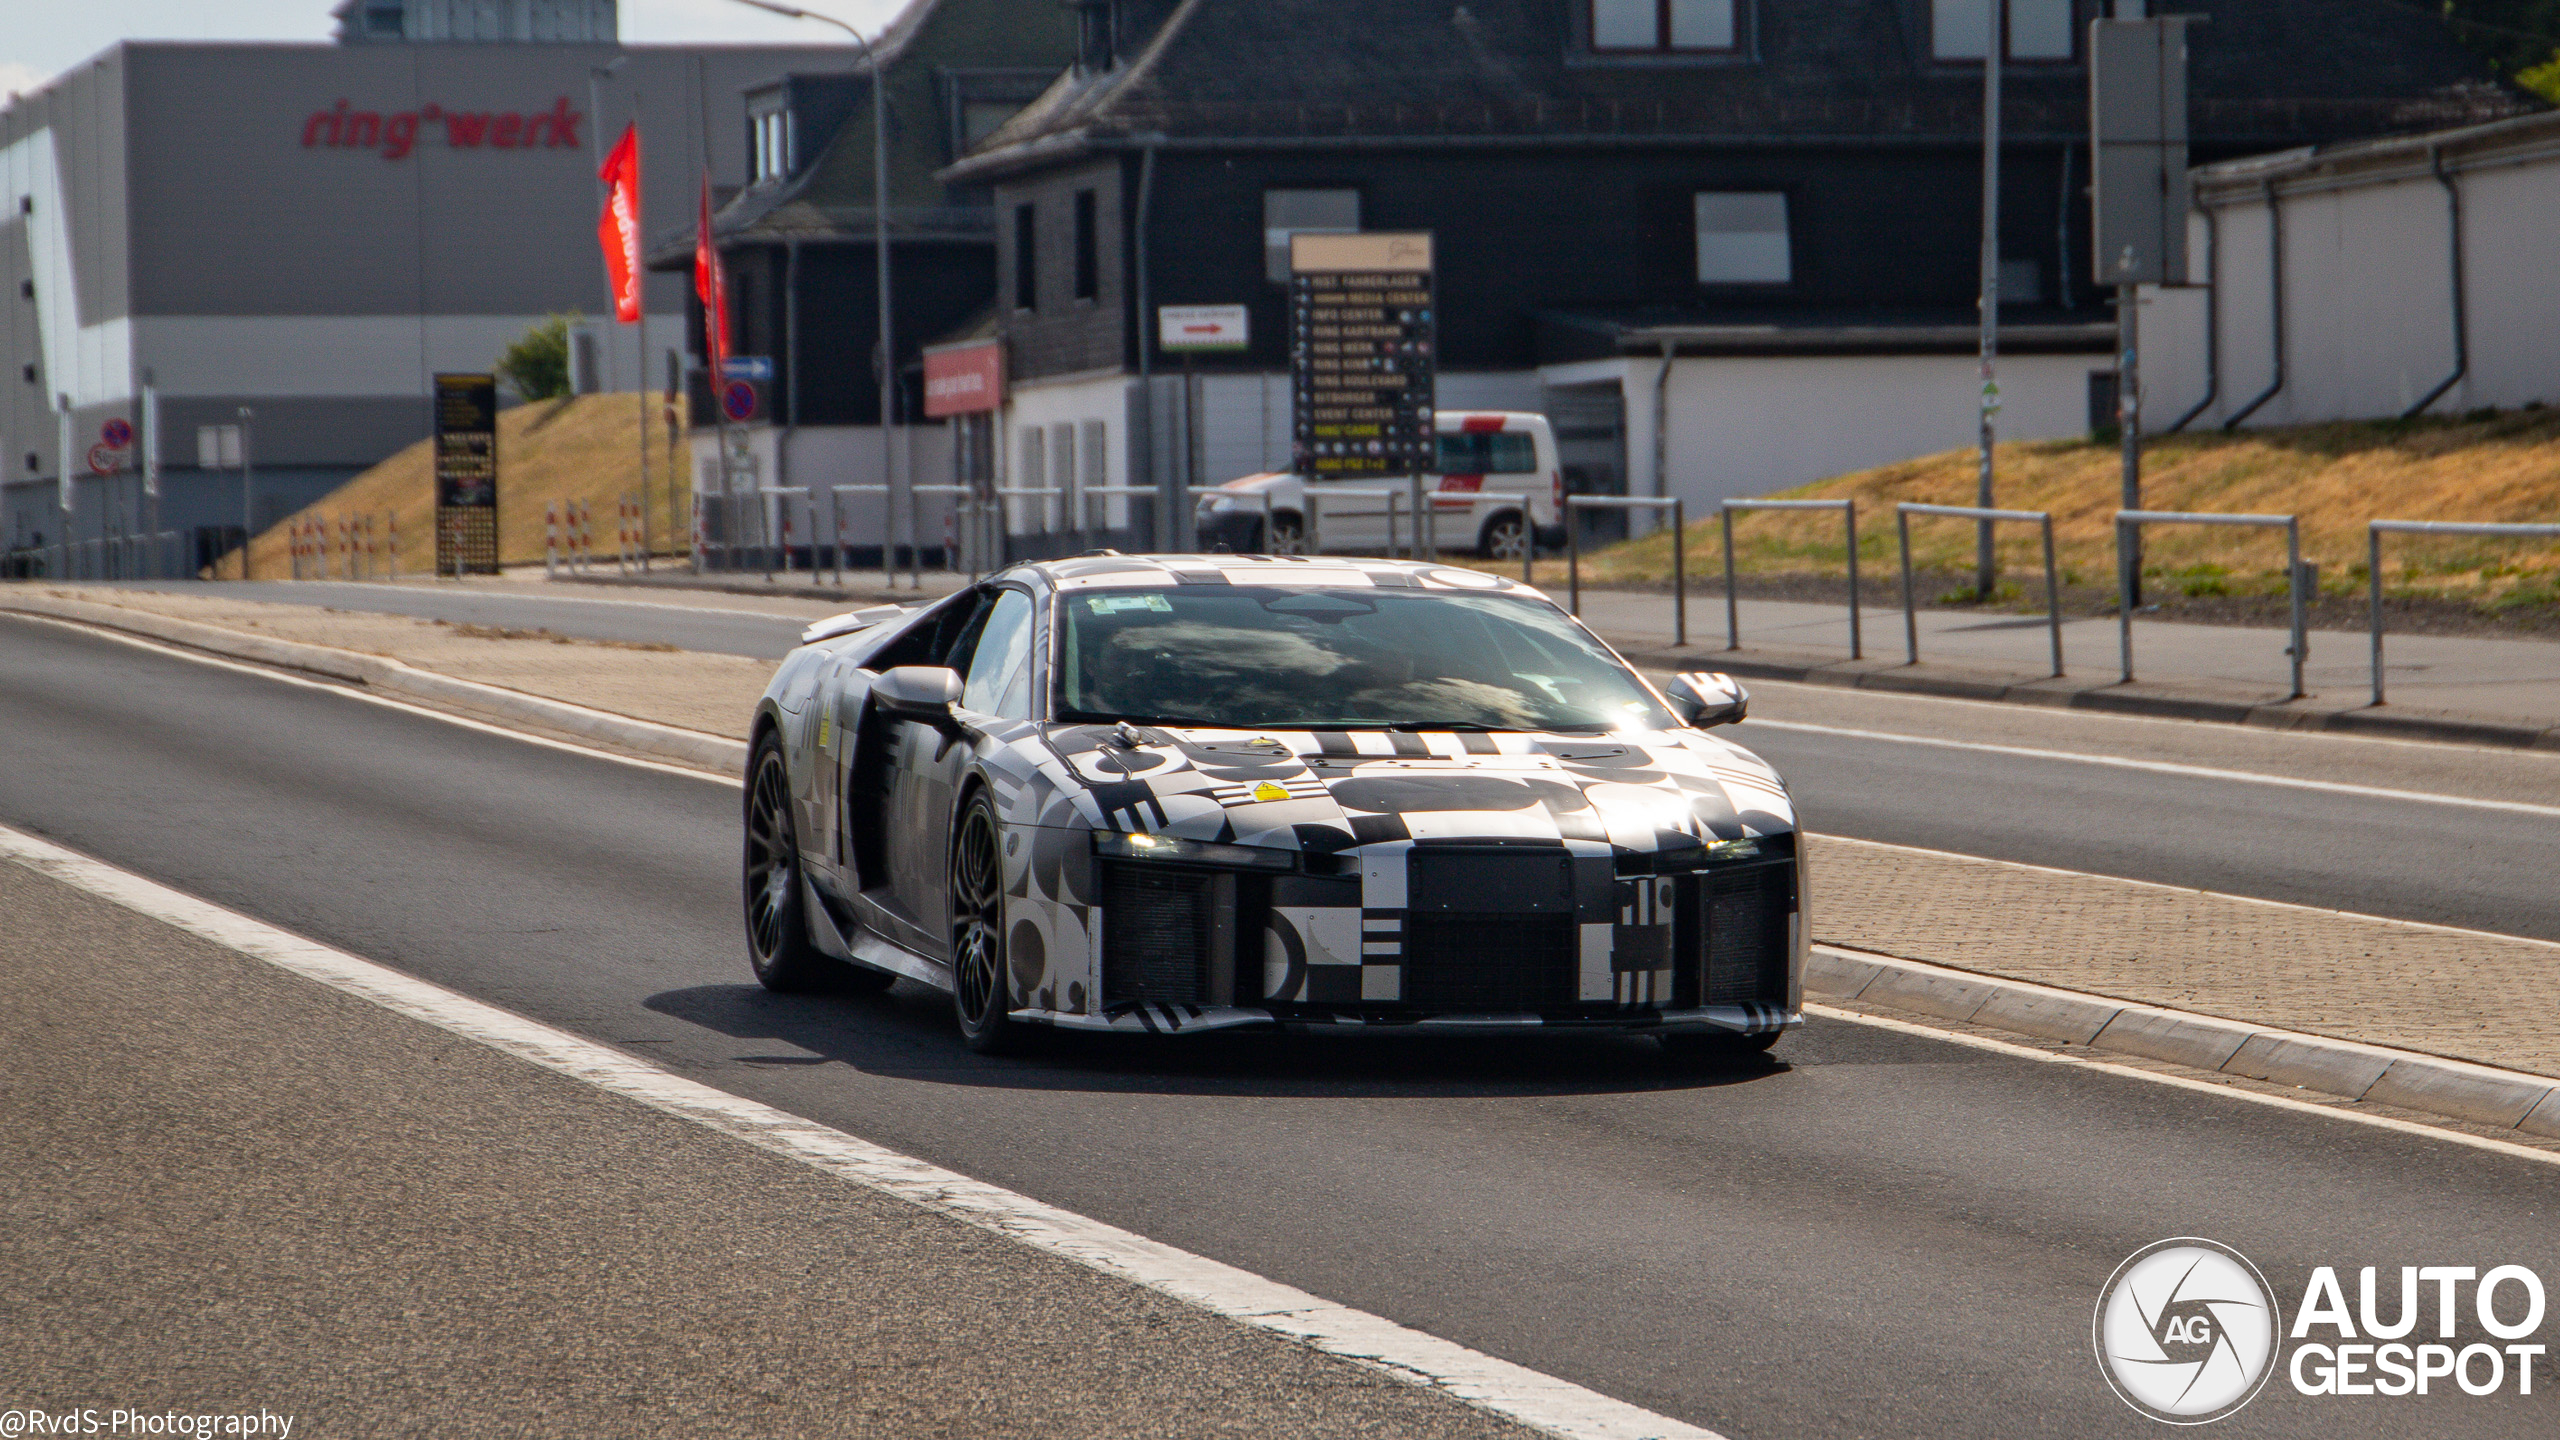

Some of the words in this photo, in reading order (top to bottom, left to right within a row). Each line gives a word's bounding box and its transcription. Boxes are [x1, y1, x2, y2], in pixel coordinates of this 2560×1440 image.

[1342, 275, 1421, 288] FAHRERLAGER
[1348, 292, 1384, 304] MEDIA
[1386, 292, 1430, 304] CENTER
[1312, 308, 1339, 321] INFO
[1340, 308, 1385, 321] CENTER
[1312, 325, 1340, 337] RING
[1342, 325, 1402, 337] KARTBAHN
[1312, 341, 1340, 354] RING
[1342, 374, 1408, 387] BOULEVARD
[1313, 391, 1376, 404] BITBURGER
[1314, 407, 1349, 420] EVENT
[1351, 407, 1395, 420] CENTER
